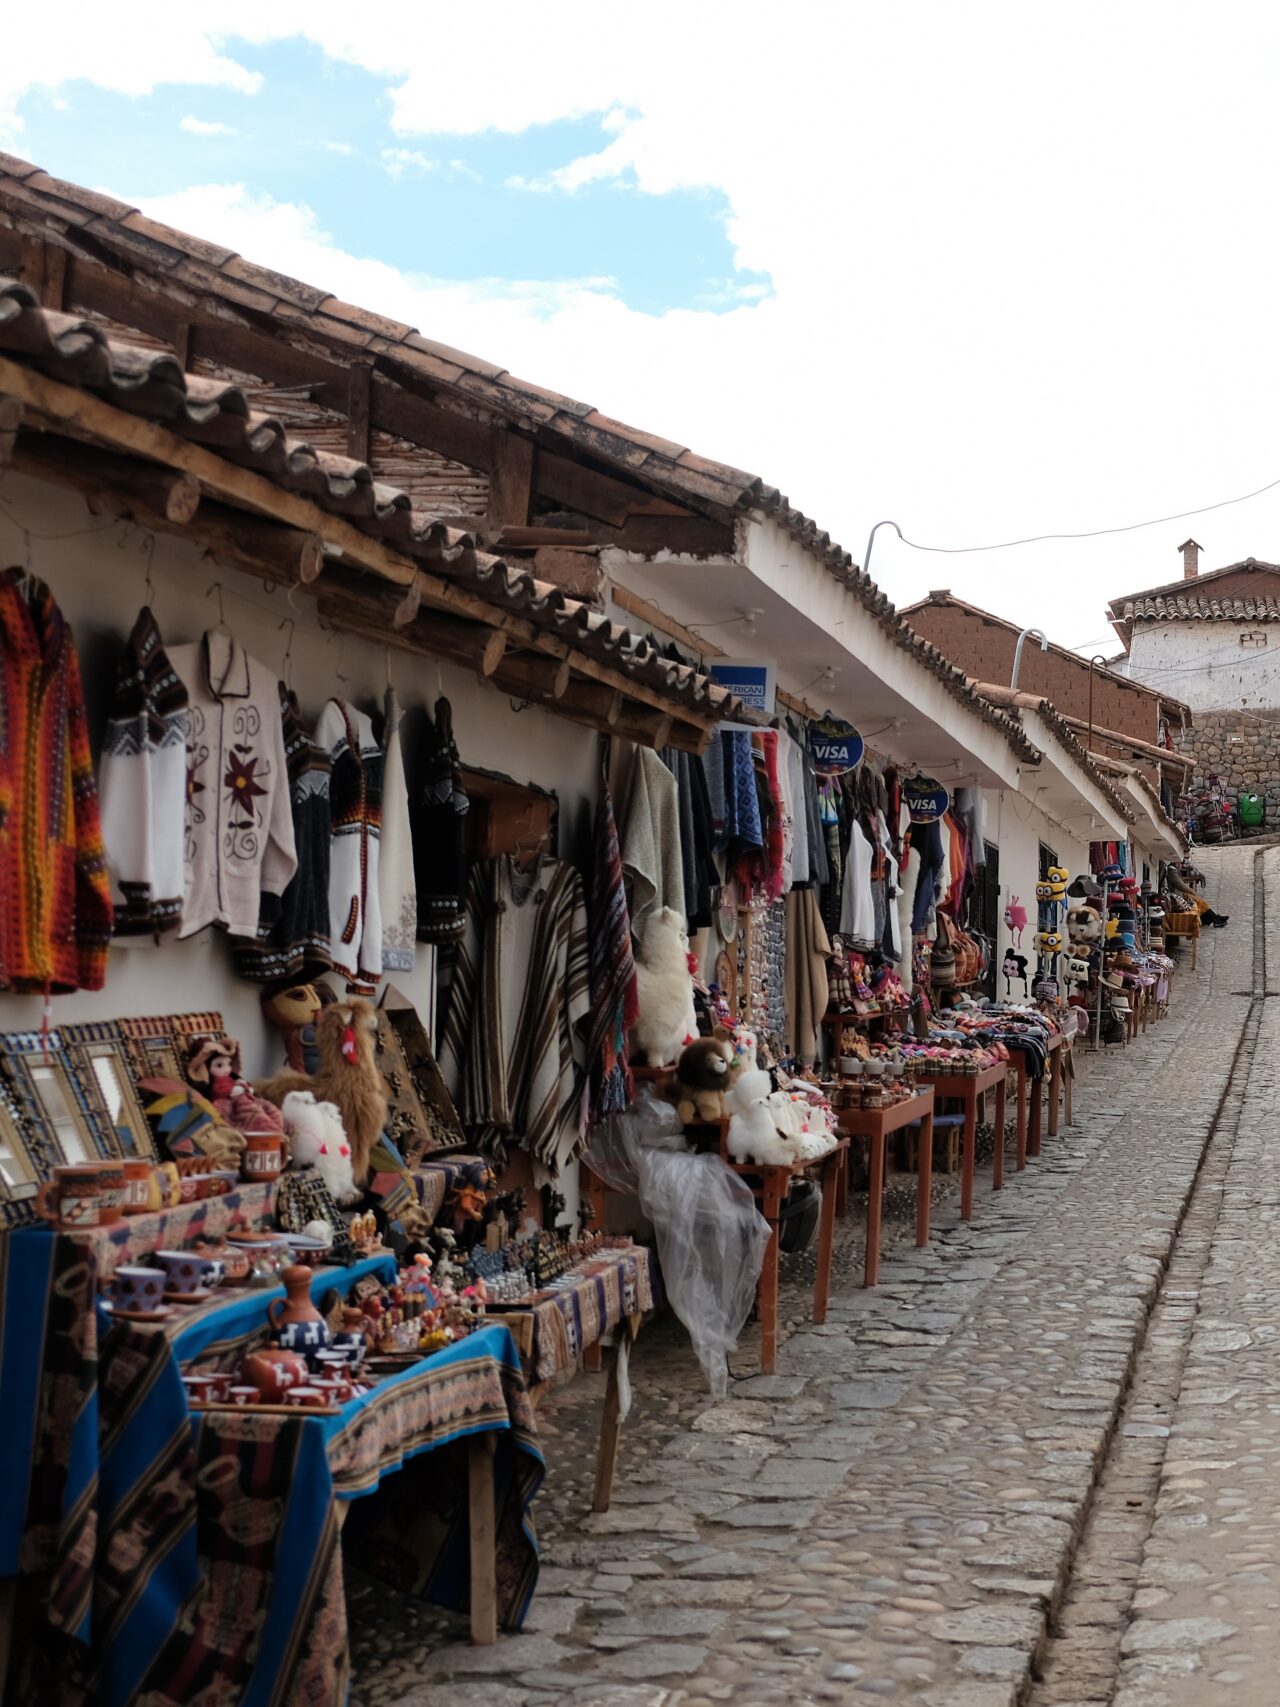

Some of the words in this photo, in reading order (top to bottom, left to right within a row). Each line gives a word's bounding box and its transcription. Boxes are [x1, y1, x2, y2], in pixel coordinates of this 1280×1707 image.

[725, 685, 762, 694] ERICAN
[741, 696, 765, 706] RESS
[813, 745, 848, 760] VISA
[909, 799, 937, 810] VISA
